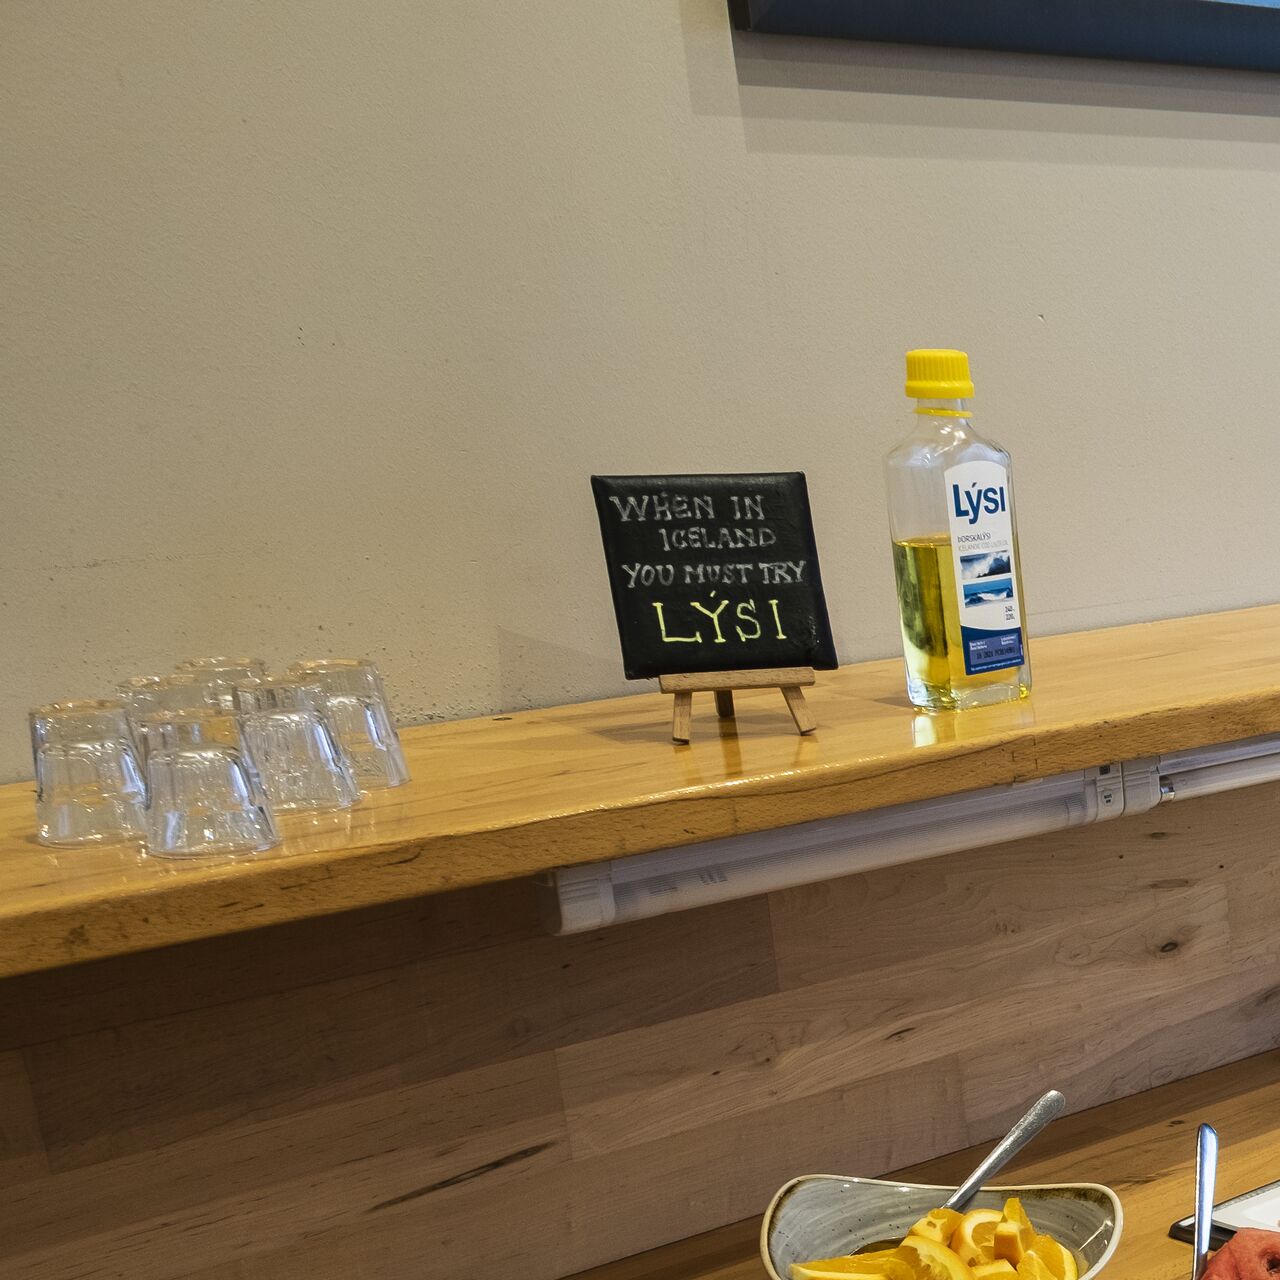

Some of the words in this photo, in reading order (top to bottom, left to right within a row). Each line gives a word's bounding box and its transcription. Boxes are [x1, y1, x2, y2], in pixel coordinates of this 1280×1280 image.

[608, 494, 715, 522] WHEN
[730, 495, 767, 521] IN
[658, 526, 777, 552] ICELAND
[621, 562, 675, 589] YOU
[682, 563, 753, 585] MUST
[758, 560, 808, 585] TRY
[651, 590, 788, 643] LÝSI
